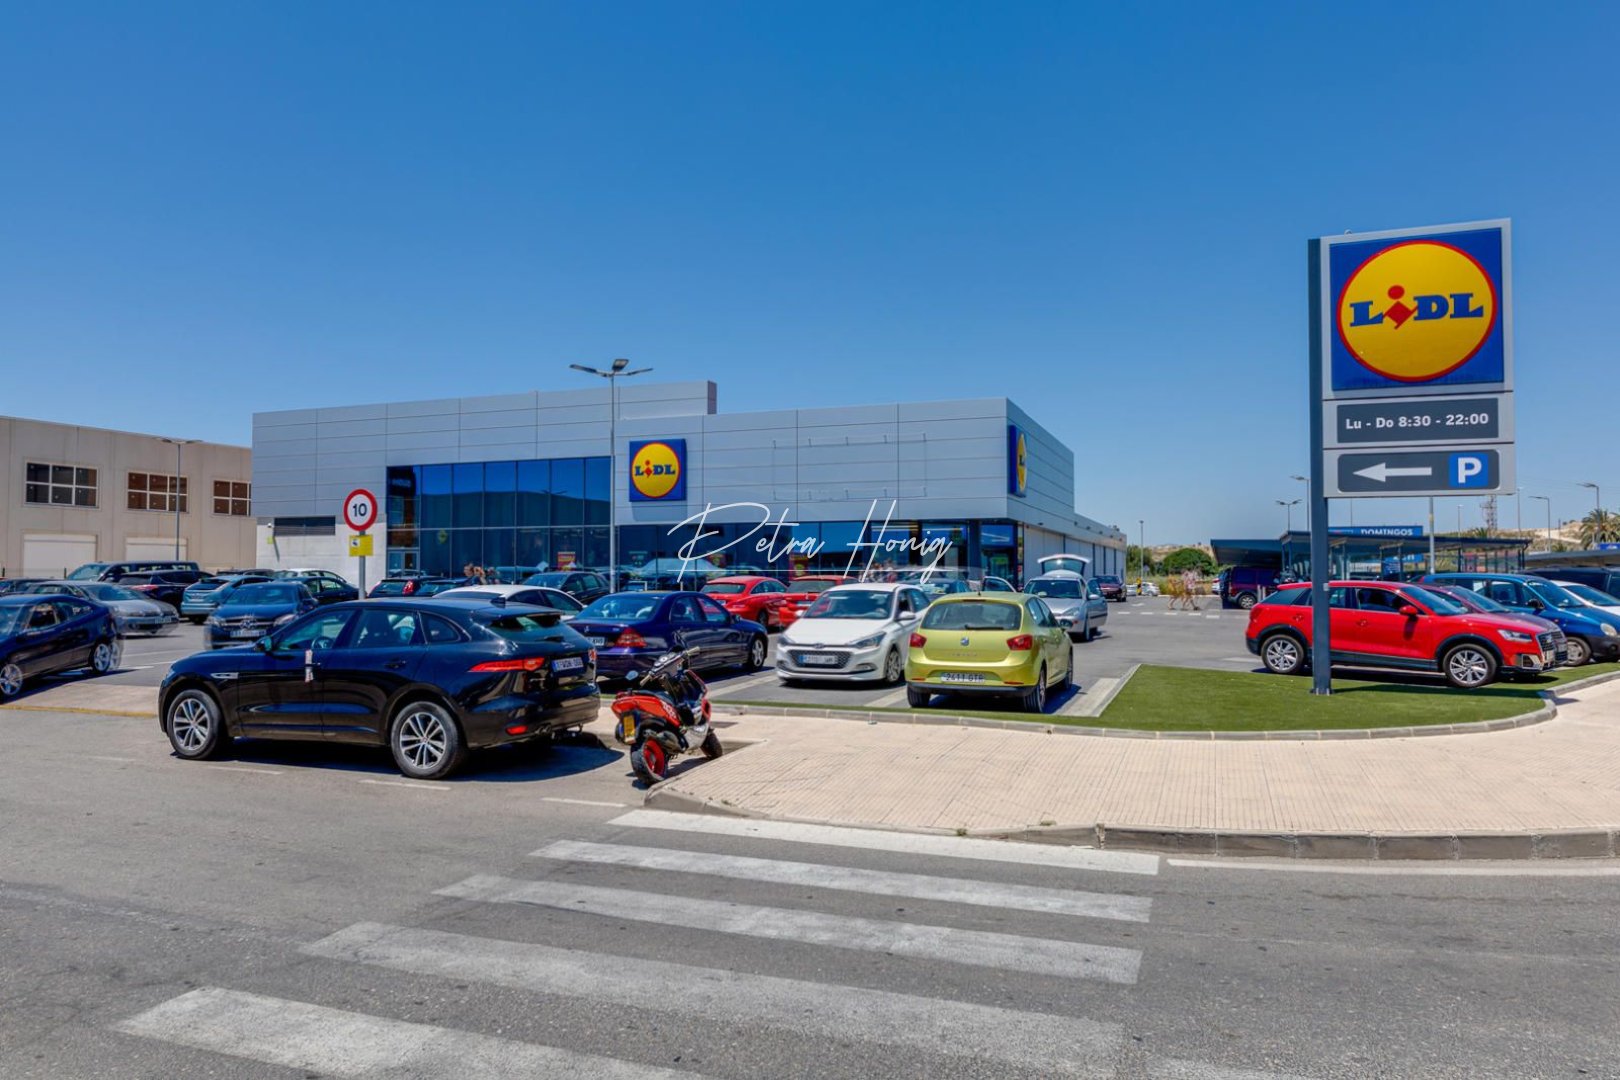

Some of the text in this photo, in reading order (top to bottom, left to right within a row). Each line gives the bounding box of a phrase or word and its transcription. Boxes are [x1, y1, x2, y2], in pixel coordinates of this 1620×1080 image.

[1345, 418, 1362, 429] Lu
[1375, 417, 1394, 429] Do
[1398, 415, 1431, 427] 8:30
[1445, 413, 1489, 426] 22:00
[1457, 457, 1482, 483] P
[352, 503, 367, 517] 10
